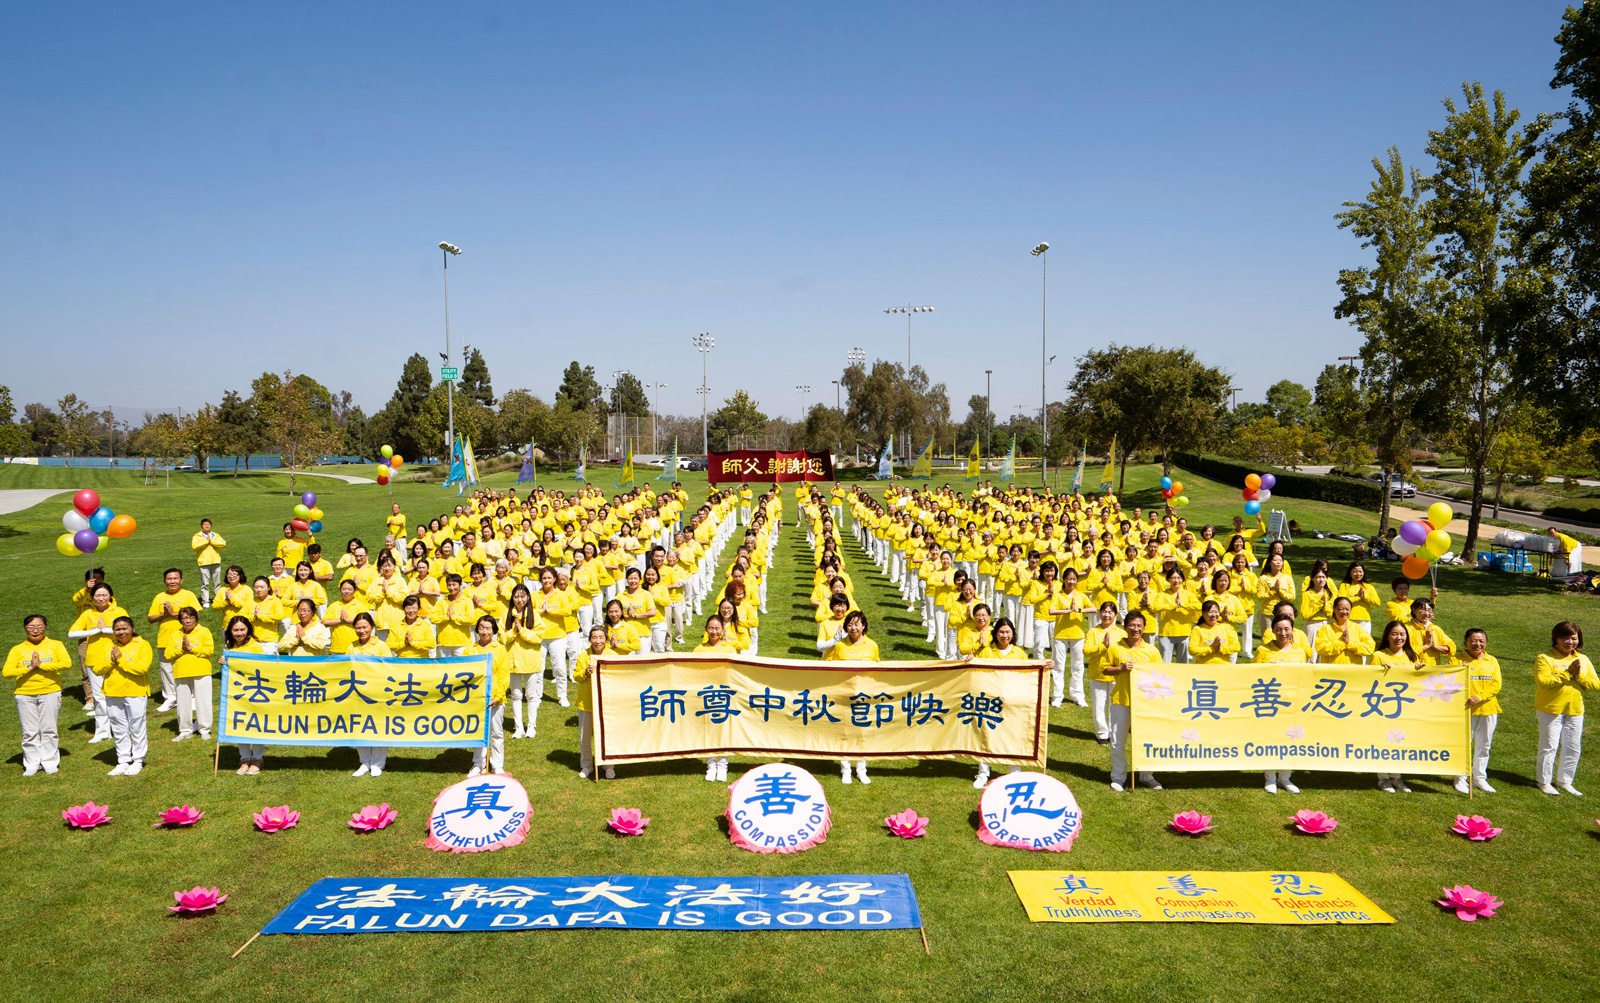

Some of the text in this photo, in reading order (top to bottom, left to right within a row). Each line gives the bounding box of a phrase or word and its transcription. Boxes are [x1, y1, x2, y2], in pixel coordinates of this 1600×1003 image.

[233, 669, 480, 707] 法輪大法好
[639, 684, 1005, 730] 師尊中秋節快樂
[233, 711, 480, 736] FALUN DAFA IS GOOD
[1143, 742, 1451, 762] Truthfulness Compassion Forbearance
[444, 783, 515, 820] 真
[743, 772, 812, 818] 善
[1003, 781, 1068, 822] 忍
[432, 811, 526, 848] TRUTHFULNESS
[734, 802, 825, 848] COMPASSION
[315, 881, 887, 911] 法輪大法好
[1053, 874, 1104, 895] 真
[1156, 874, 1218, 897] 善
[1269, 874, 1325, 897] 忍
[1043, 906, 1142, 919] Truthfulness
[1059, 896, 1117, 906] Verdad
[1271, 897, 1357, 909] Tolerancia
[294, 909, 893, 930] FALUN DAFA IS GOOD
[1163, 908, 1257, 921] Compassion
[1289, 910, 1372, 921] Tolerance
